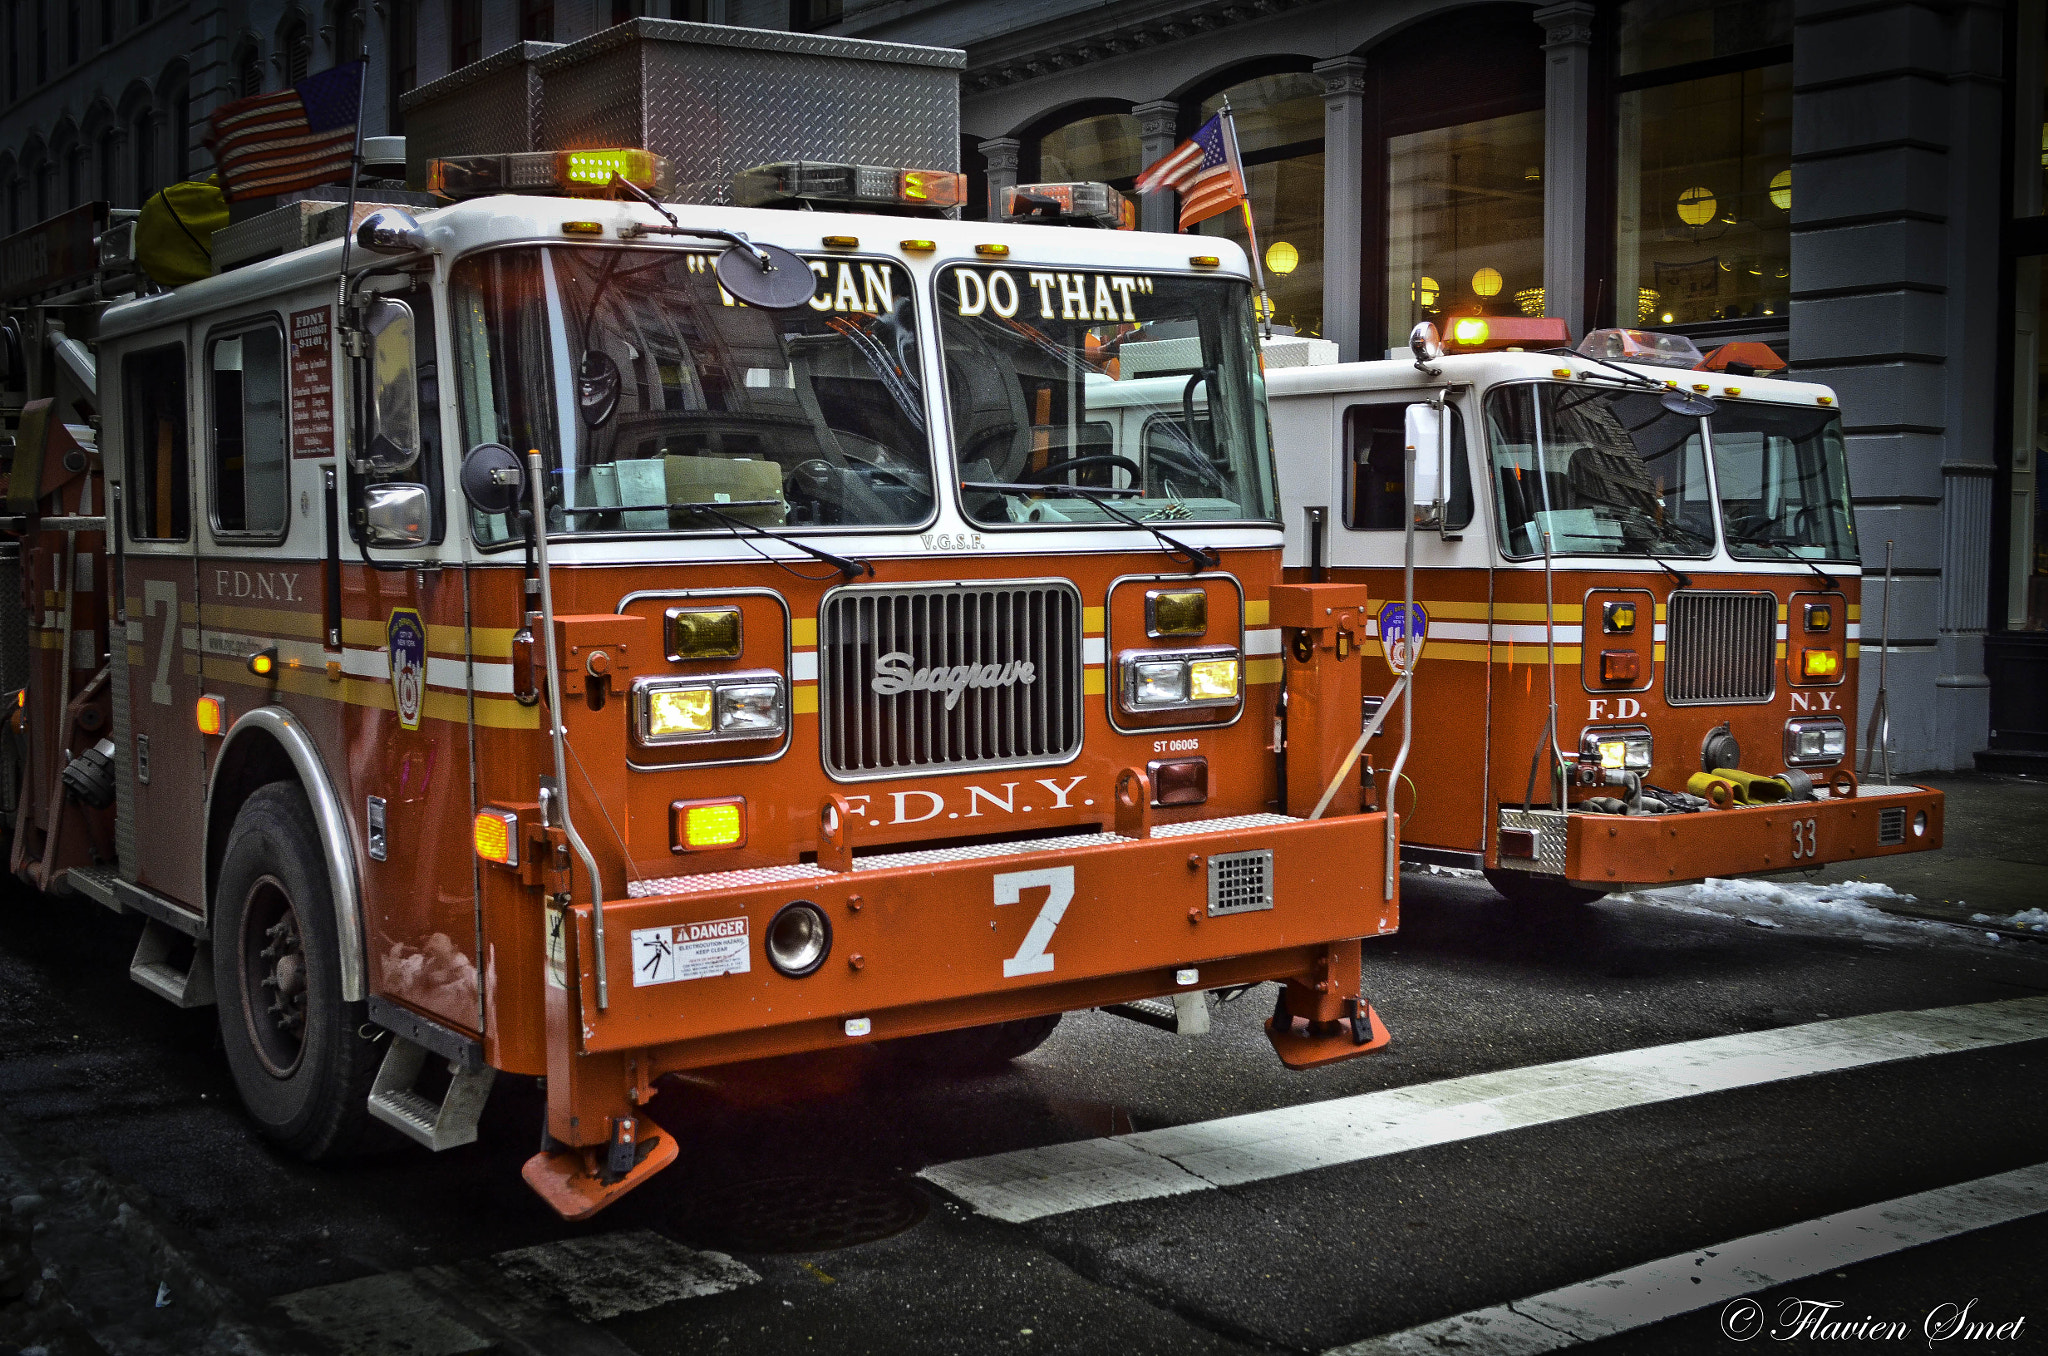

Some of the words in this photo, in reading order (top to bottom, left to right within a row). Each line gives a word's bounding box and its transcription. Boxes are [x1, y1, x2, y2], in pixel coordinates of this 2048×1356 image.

[808, 260, 893, 313] CAN
[954, 268, 1019, 318] DO
[293, 327, 309, 339] NEVER
[296, 312, 325, 328] FDNY
[920, 534, 985, 550] V.G.S.F.
[215, 569, 303, 602] F.D.N.Y.
[144, 579, 178, 706] 7
[871, 651, 1037, 711] Seagrave
[1587, 697, 1648, 720] F.D.
[1788, 691, 1842, 712] N.Y.
[1154, 741, 1168, 752] ST
[1170, 738, 1199, 751] 06005
[1791, 818, 1816, 859] 33
[690, 920, 744, 940] DANGER
[993, 865, 1075, 978] 7
[678, 940, 722, 951] ELECTROCUTION
